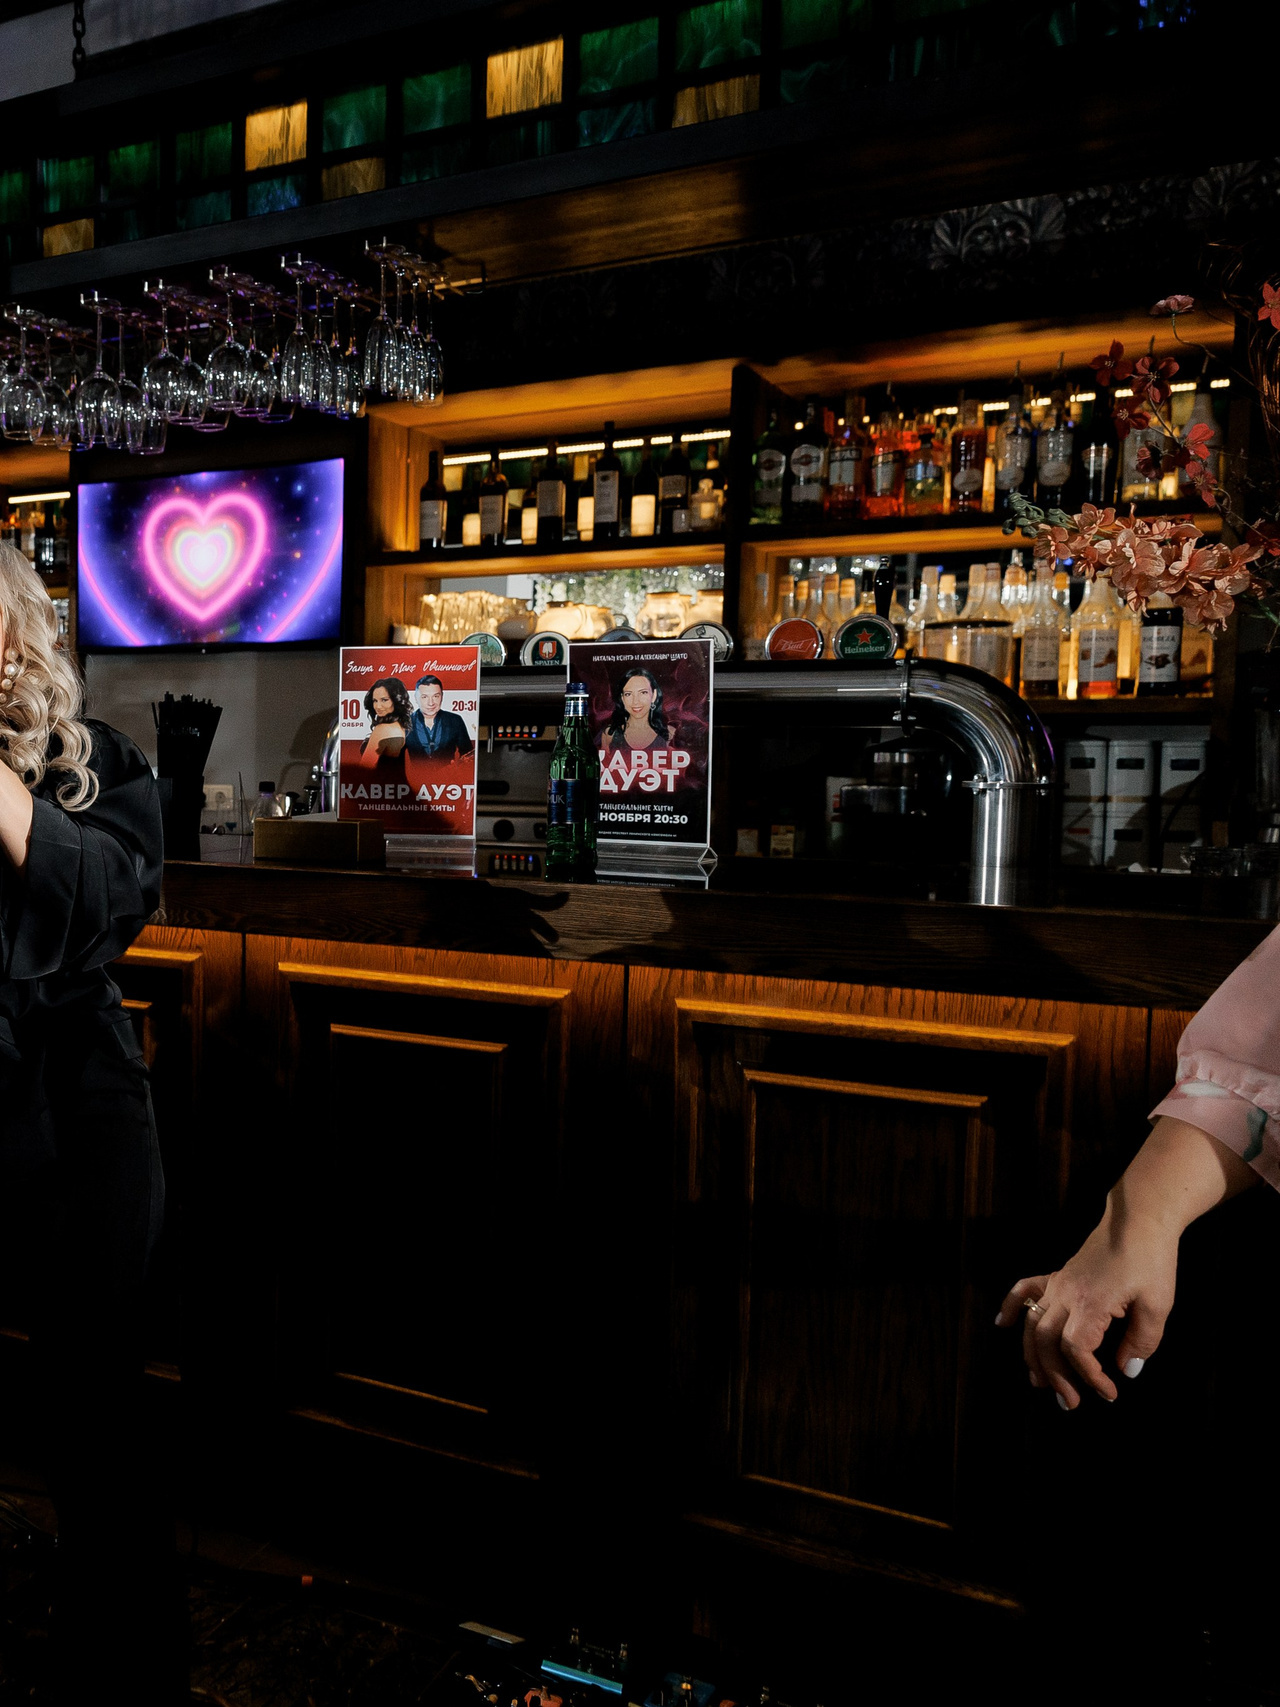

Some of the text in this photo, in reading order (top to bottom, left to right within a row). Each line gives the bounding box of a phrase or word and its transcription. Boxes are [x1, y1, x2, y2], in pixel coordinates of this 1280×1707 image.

[844, 643, 886, 654] Heineken
[341, 699, 360, 720] 10
[599, 768, 680, 793] ДУЭТ
[341, 783, 475, 802] КАВЕР ДУЭТ
[358, 803, 456, 812] ТАНЦЕВАЛЬНЫЕ ХИТЫ
[599, 803, 651, 811] ТАНЦЕВАЛЬНЫЕ
[600, 812, 688, 825] НОЯБРЯ 20:30
